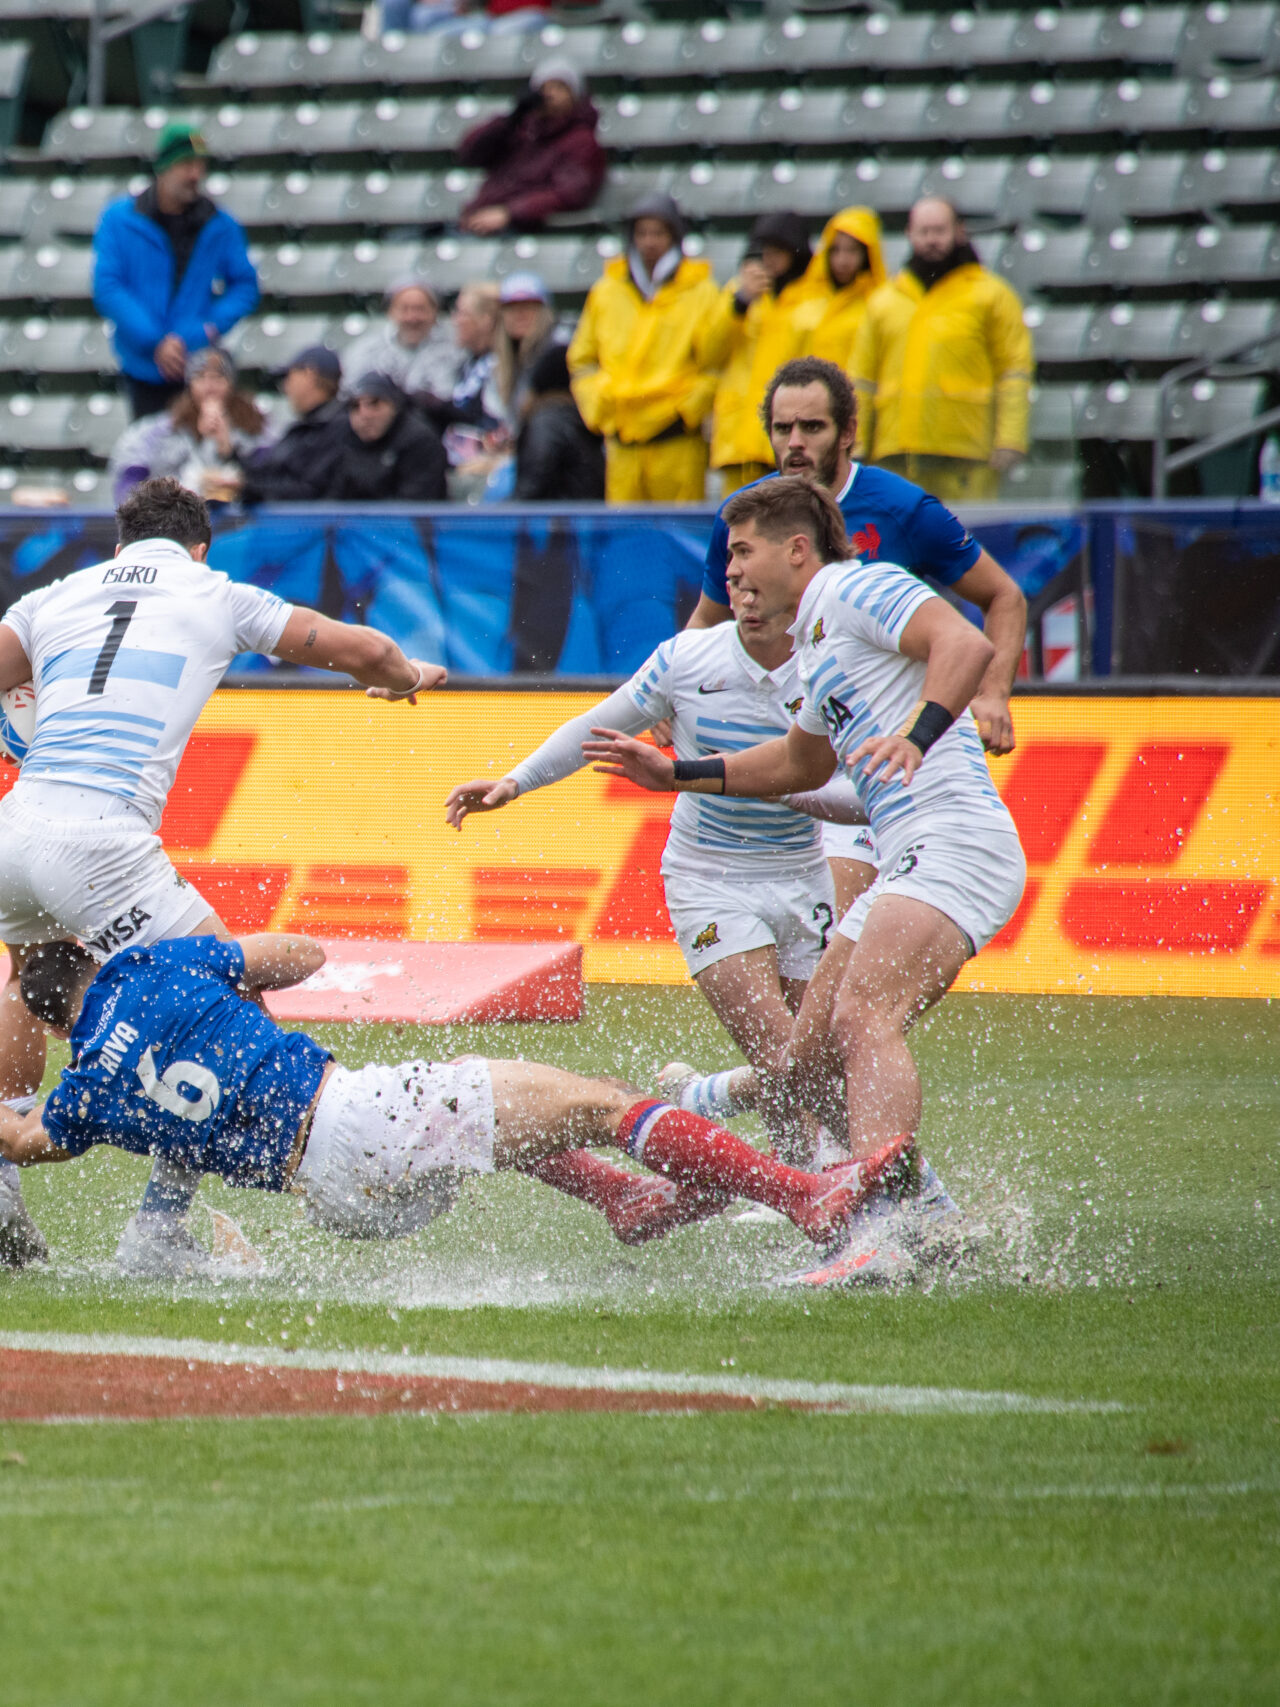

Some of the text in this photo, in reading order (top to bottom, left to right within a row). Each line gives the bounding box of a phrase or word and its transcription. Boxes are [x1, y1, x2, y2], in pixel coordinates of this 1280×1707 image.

[102, 565, 158, 585] ISGRO
[87, 600, 138, 695] 1
[85, 905, 153, 955] VISA
[98, 1020, 139, 1076] RIVA
[136, 1044, 221, 1122] 6
